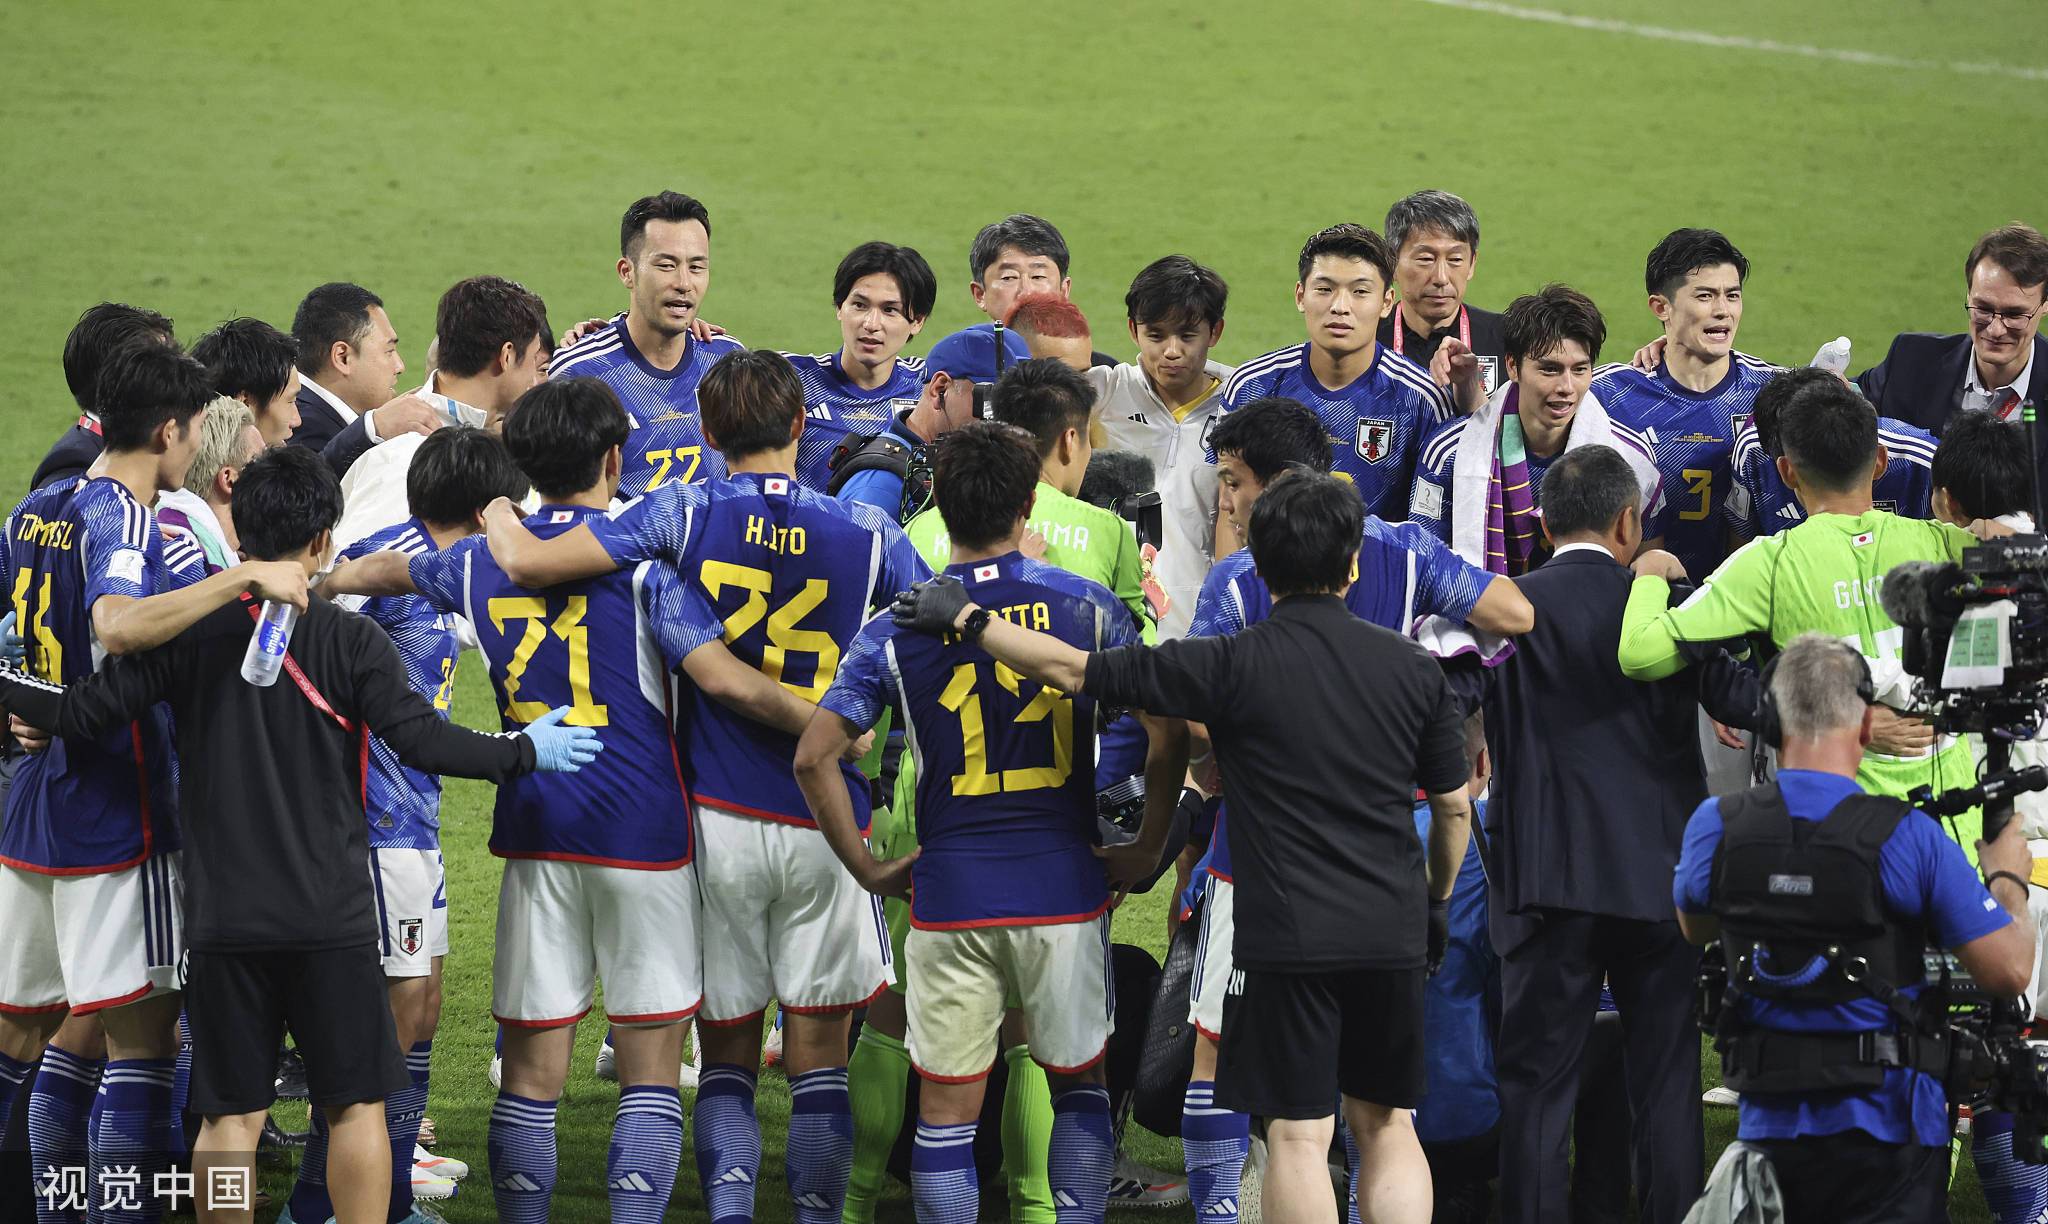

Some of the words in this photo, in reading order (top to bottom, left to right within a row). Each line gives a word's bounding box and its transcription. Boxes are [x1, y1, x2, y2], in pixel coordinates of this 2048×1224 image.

[1679, 469, 1712, 520] 3
[745, 514, 806, 555] H.ITO
[11, 566, 63, 685] 16
[266, 625, 283, 655] smart
[699, 559, 840, 706] 26
[487, 595, 609, 727] 21
[394, 1110, 426, 1123] JAP
